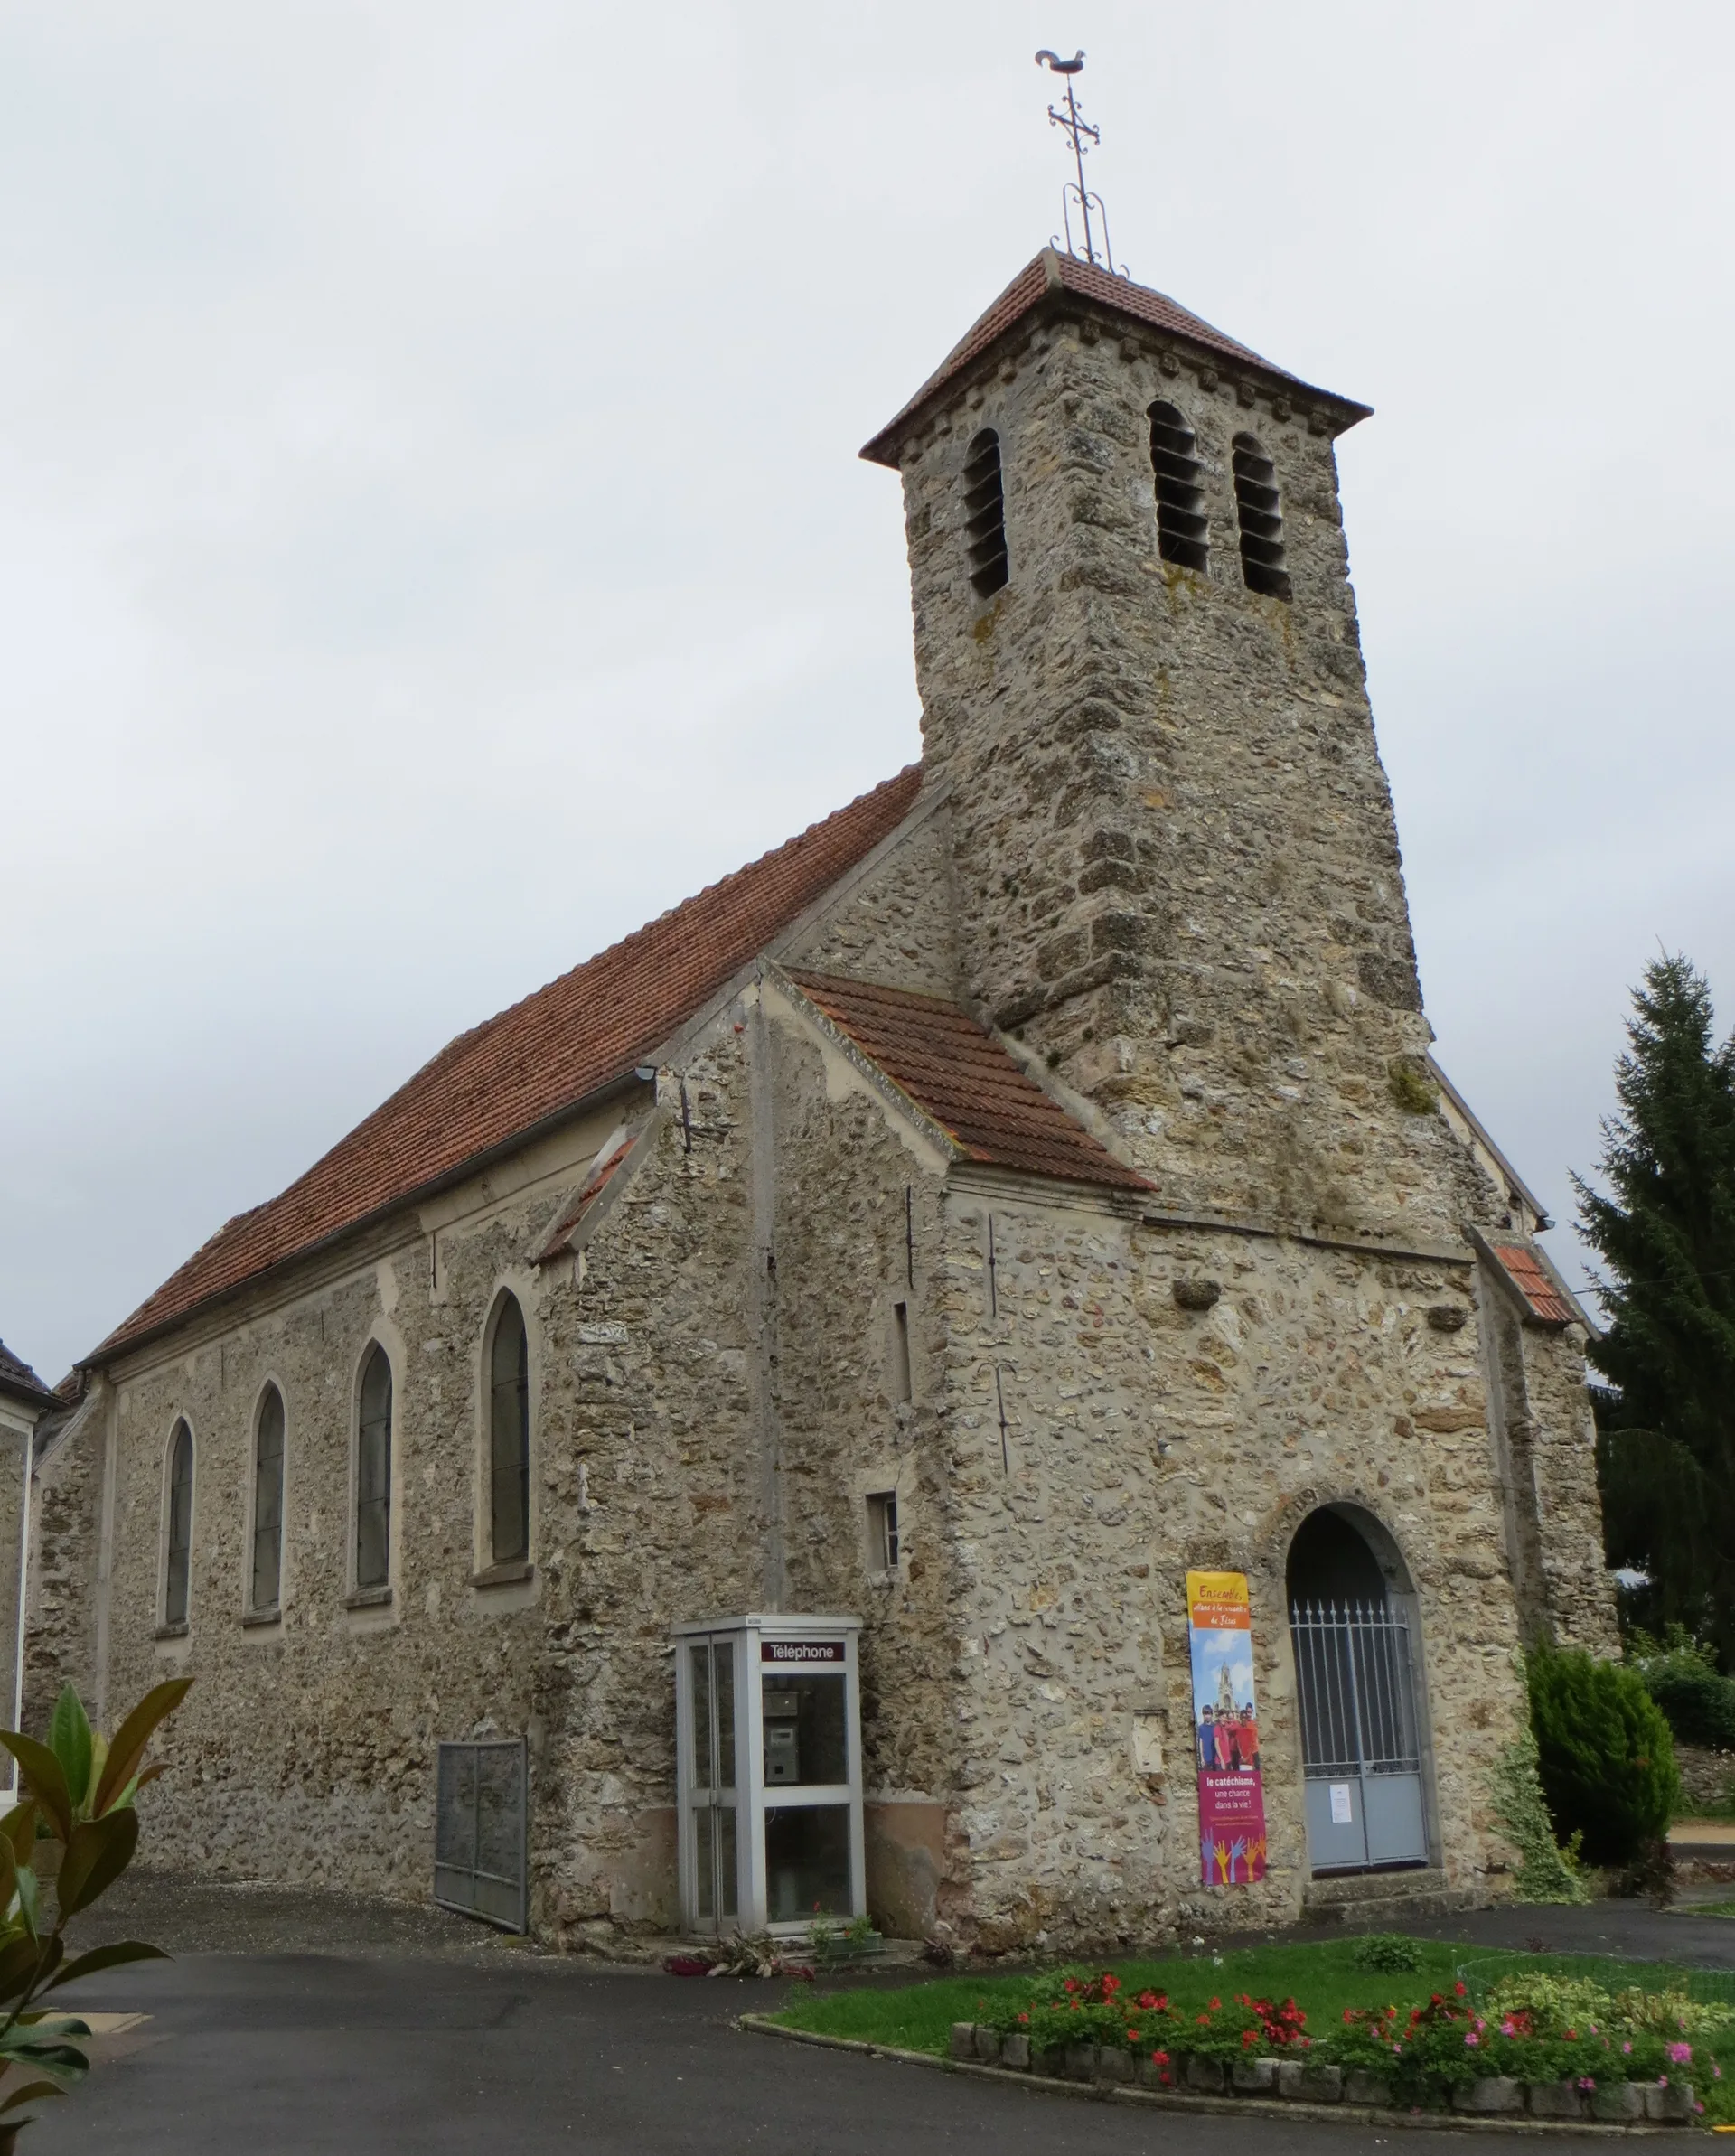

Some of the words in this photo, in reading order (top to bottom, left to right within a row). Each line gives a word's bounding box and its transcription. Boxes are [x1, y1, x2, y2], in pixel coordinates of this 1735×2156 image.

[1199, 1585, 1243, 1601] Ensemble,
[1210, 1615, 1218, 1625] de
[1220, 1614, 1237, 1626] Jésus
[770, 1645, 835, 1661] Téléphone
[1206, 1777, 1214, 1786] le
[1214, 1776, 1256, 1786] catéchisme,
[1228, 1789, 1251, 1797] chance
[1214, 1801, 1232, 1809] dans
[1232, 1800, 1238, 1808] la
